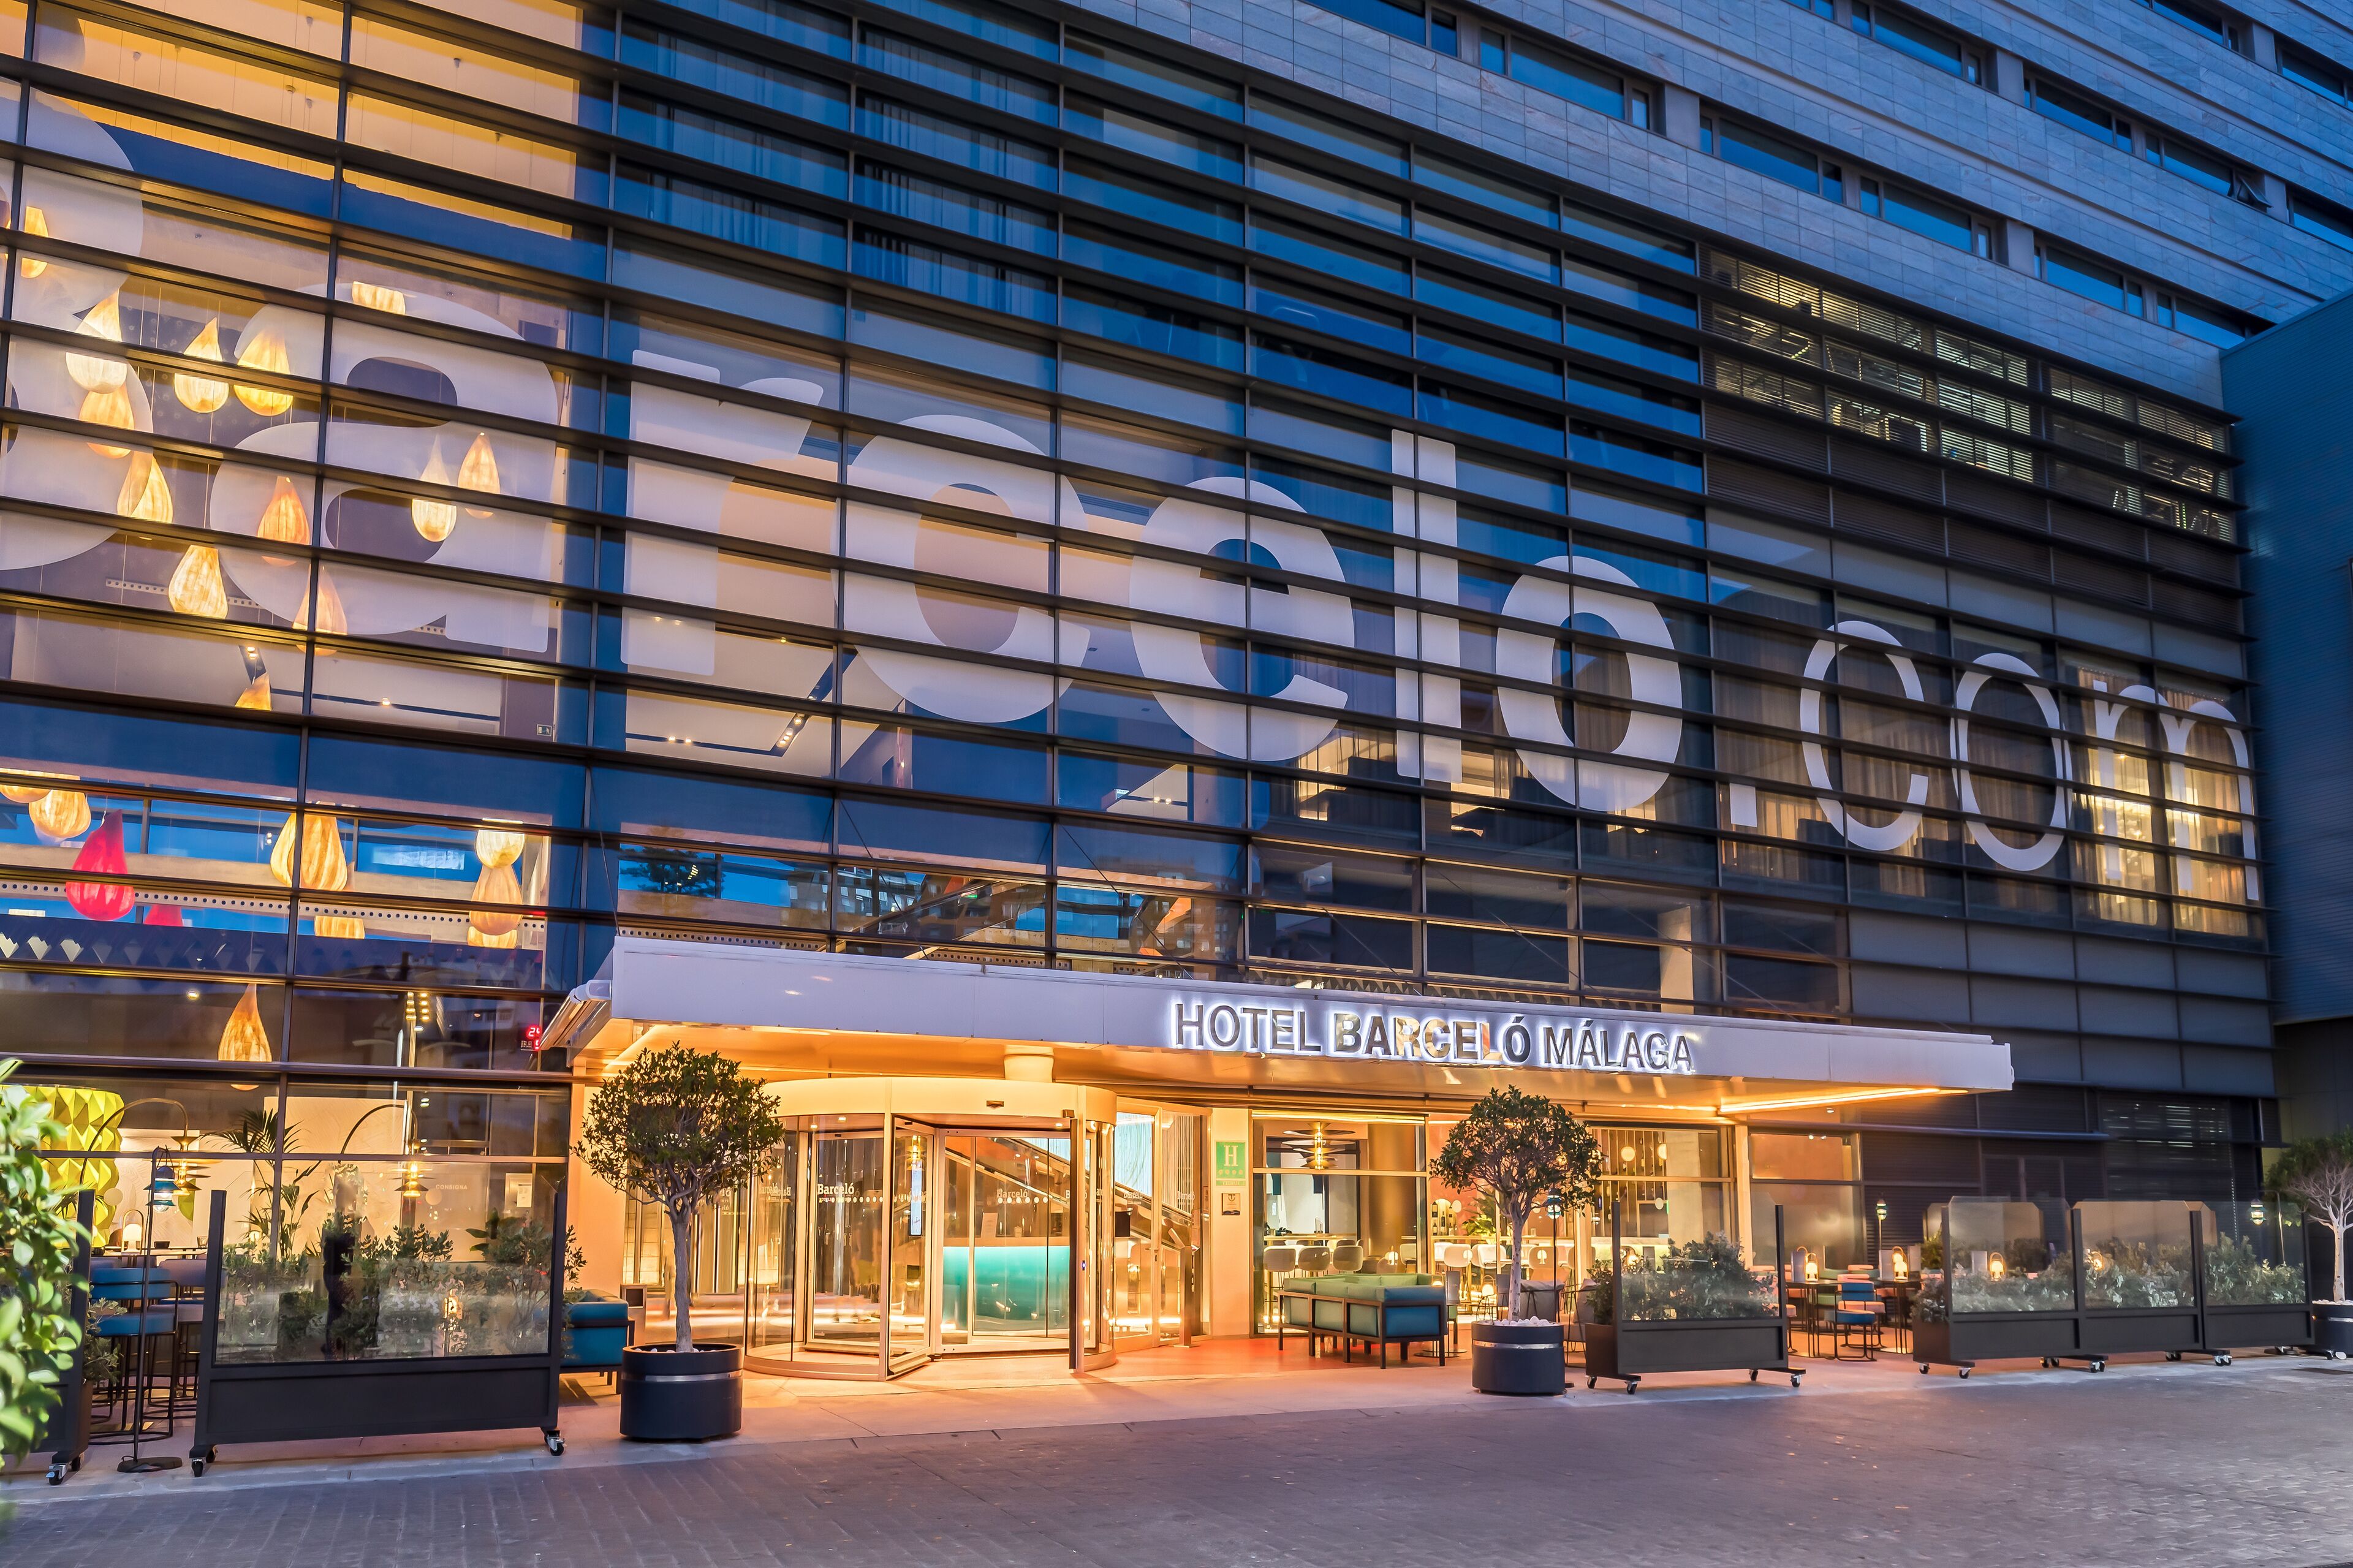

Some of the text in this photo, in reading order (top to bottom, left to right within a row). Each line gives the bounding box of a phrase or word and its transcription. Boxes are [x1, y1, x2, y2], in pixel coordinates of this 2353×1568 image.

[1175, 1003, 1694, 1071] HOTEL BARCELÓ MÁLAGA
[1224, 1145, 1238, 1166] H
[817, 1183, 855, 1194] Barceló
[996, 1189, 1028, 1198] Barceló
